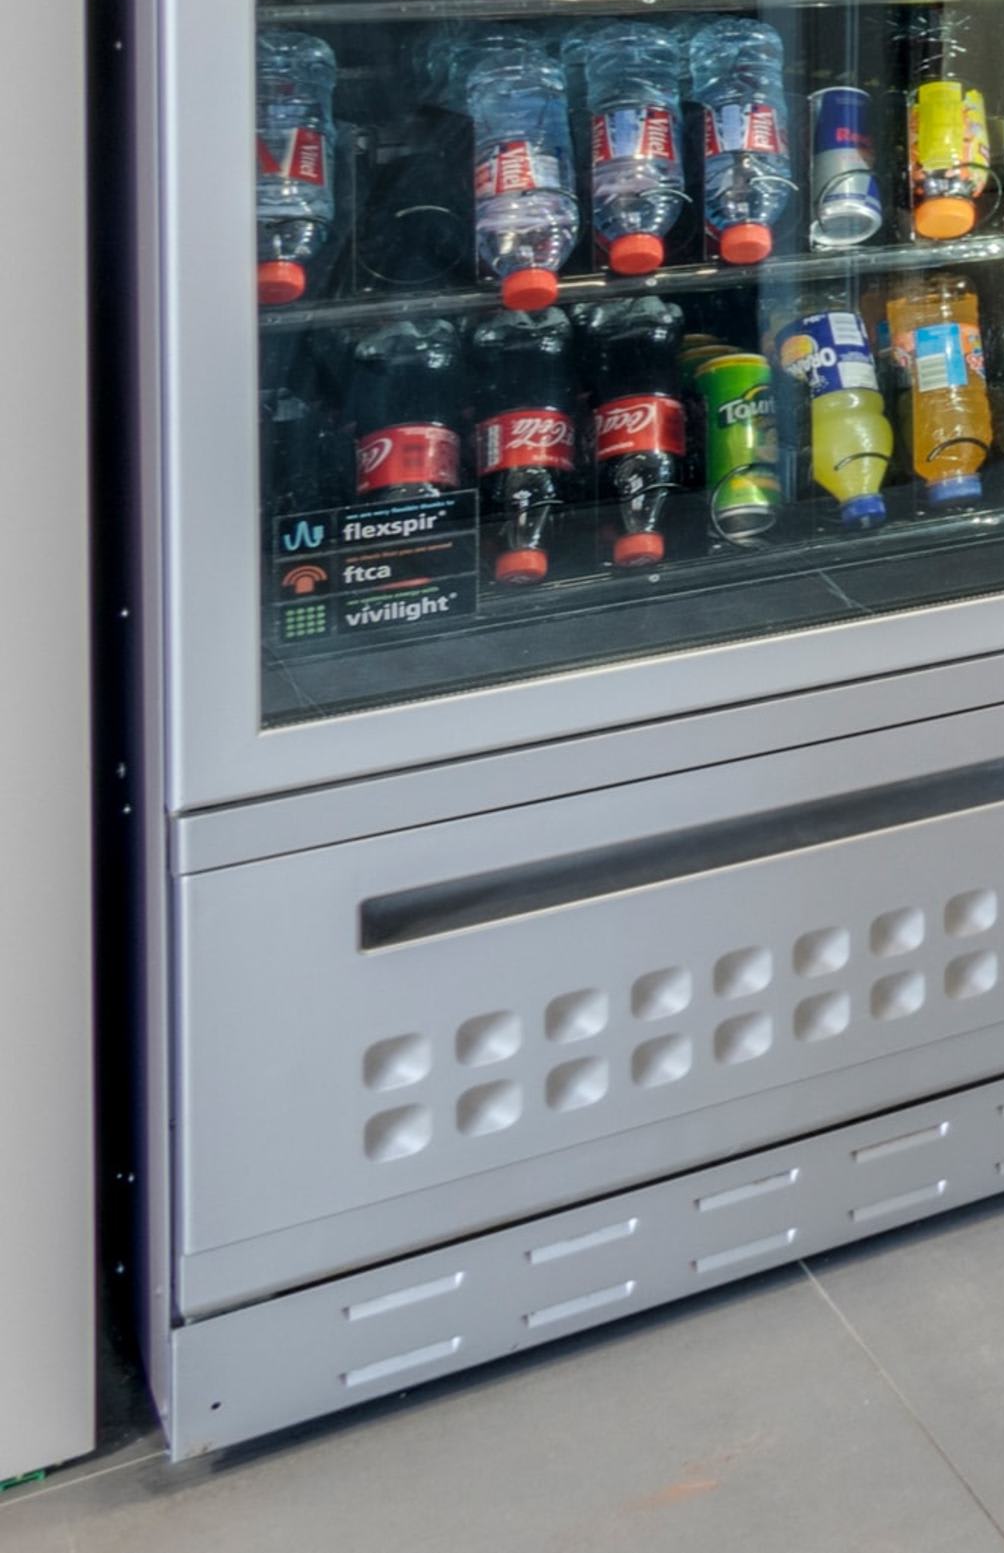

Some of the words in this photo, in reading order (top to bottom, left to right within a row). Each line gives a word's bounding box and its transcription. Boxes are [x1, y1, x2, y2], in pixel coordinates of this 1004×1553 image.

[648, 114, 670, 157] Vittel
[752, 107, 775, 150] Vittel
[343, 512, 438, 542] flexspir
[343, 564, 391, 584] ftca
[345, 594, 449, 626] vivilight
